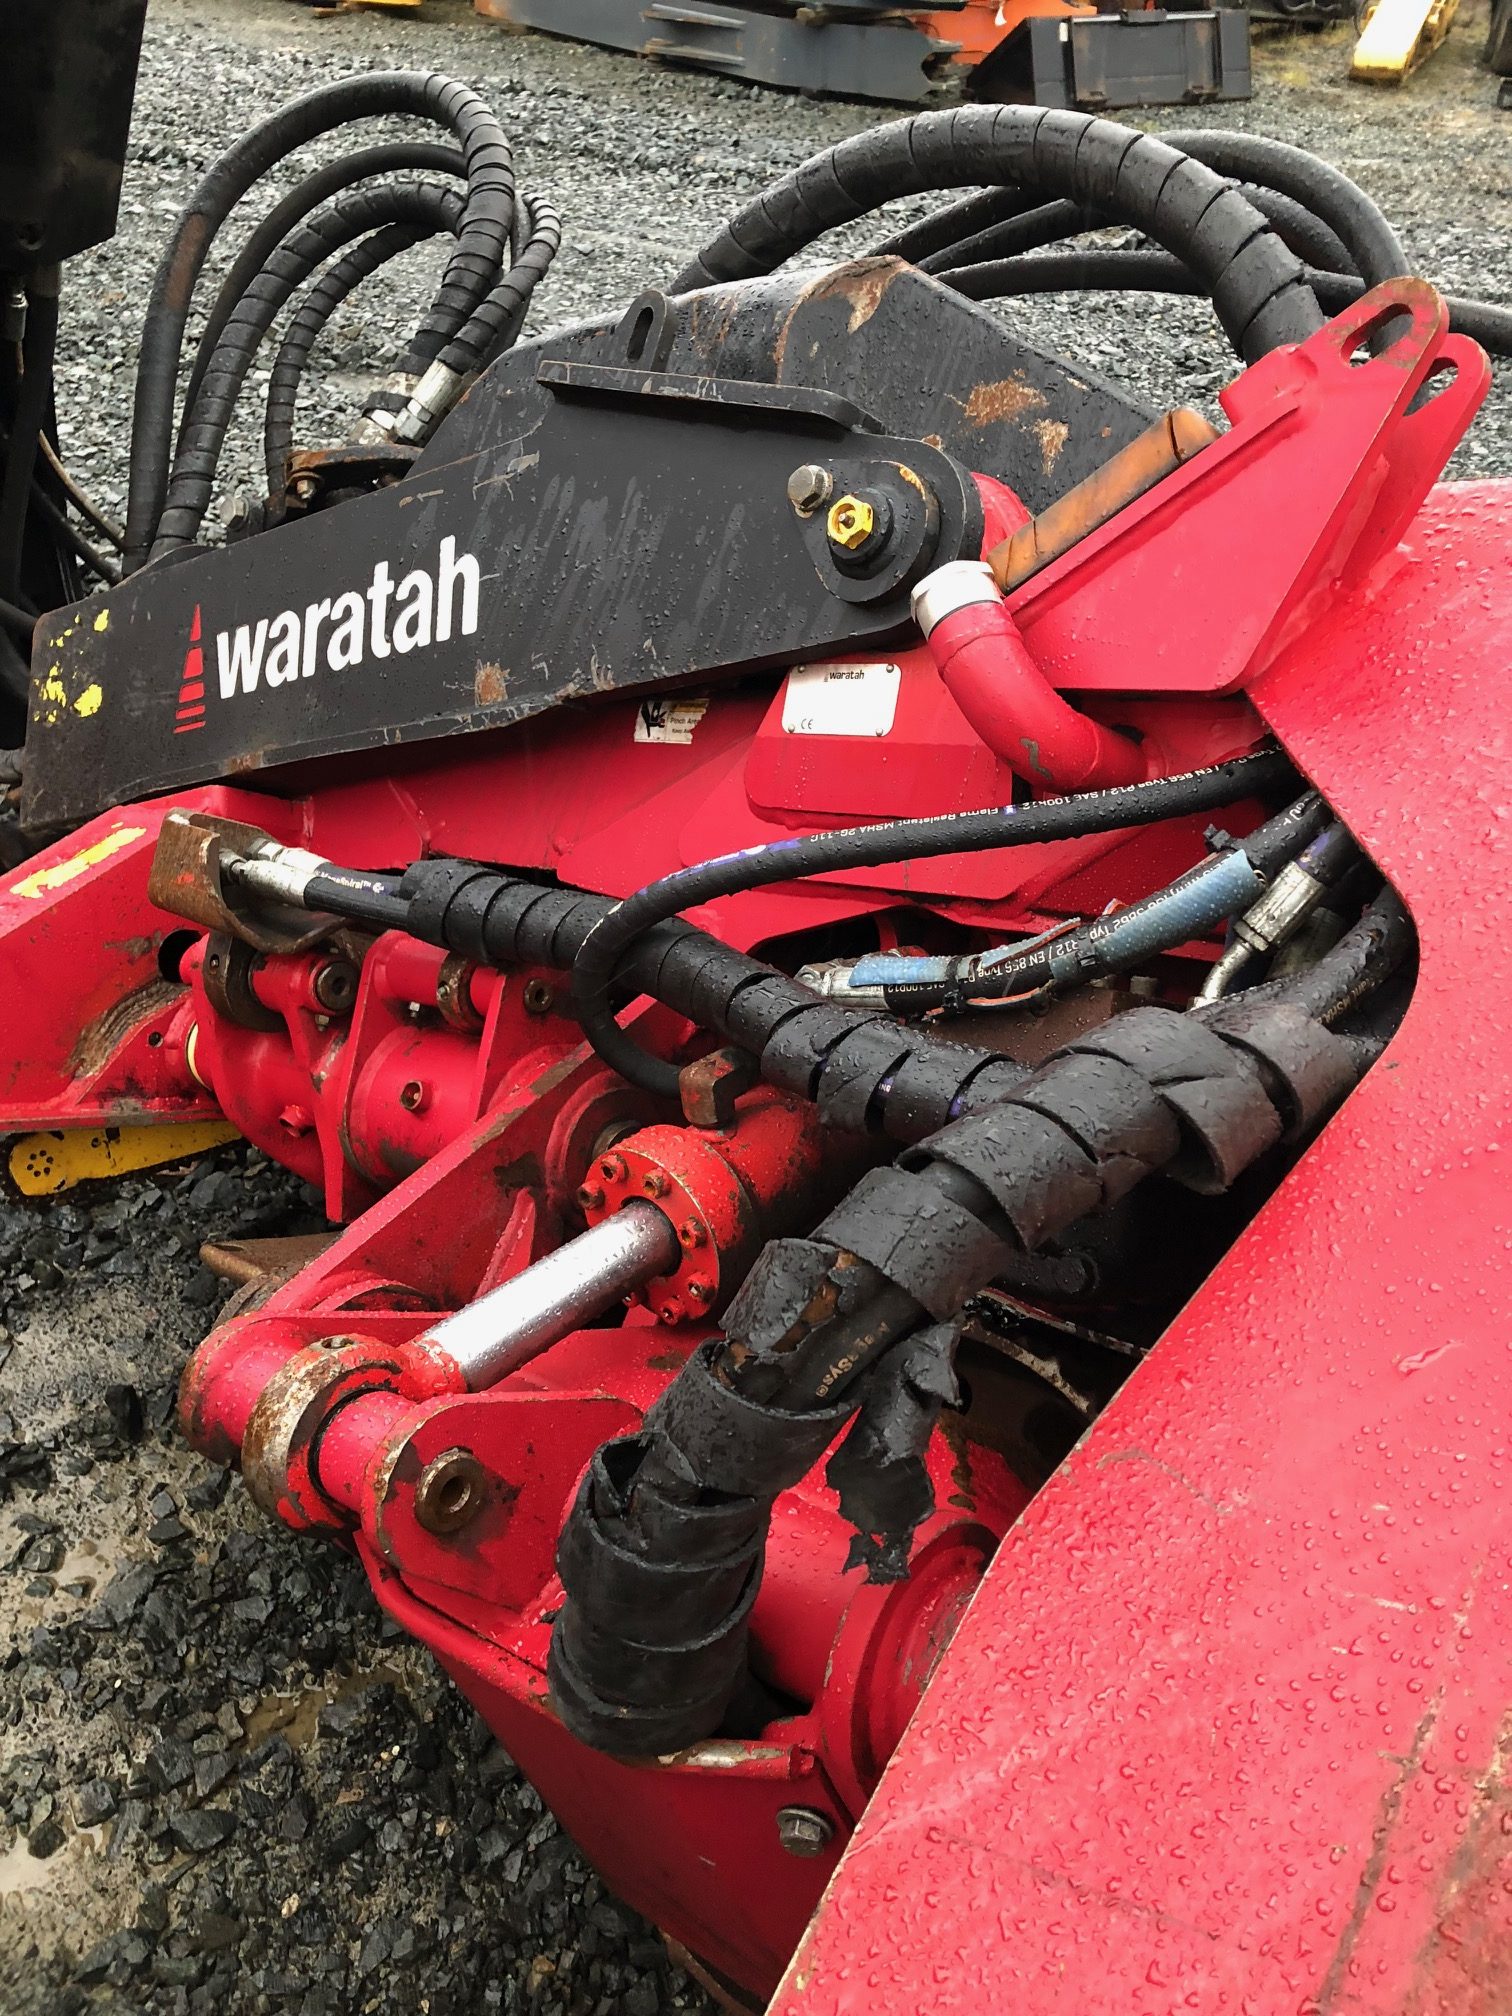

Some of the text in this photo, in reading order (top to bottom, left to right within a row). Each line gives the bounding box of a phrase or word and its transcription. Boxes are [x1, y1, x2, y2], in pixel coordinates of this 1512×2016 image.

[216, 535, 480, 699] waratah
[829, 670, 865, 680] waratah
[860, 821, 894, 834] MSHA
[1089, 925, 1111, 940] Typ
[1004, 957, 1028, 974] 856
[1029, 951, 1046, 966] EN
